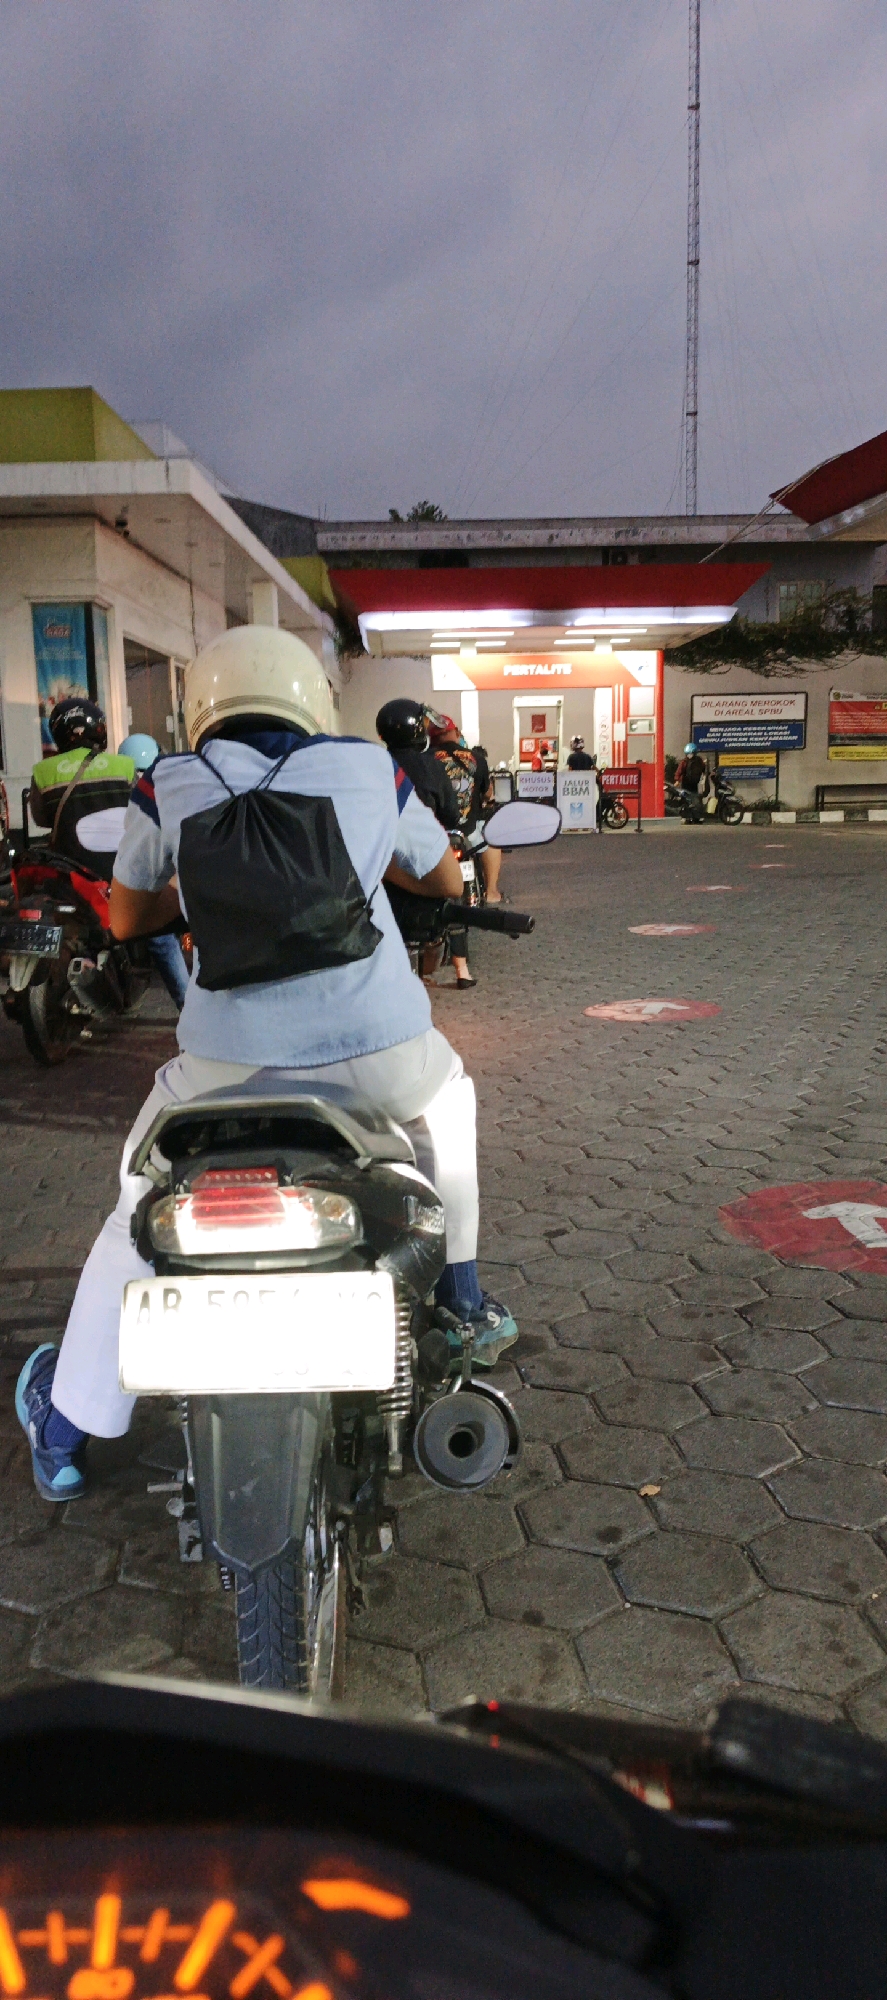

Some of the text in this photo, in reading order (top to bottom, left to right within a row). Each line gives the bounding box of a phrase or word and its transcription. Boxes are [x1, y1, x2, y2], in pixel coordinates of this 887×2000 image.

[503, 663, 572, 676] PERTALITE
[700, 699, 796, 708] DILARANG MEROKOK
[714, 709, 724, 717] DI
[725, 708, 756, 716] AREAL
[563, 779, 590, 787] JALUR
[601, 774, 639, 785] PERTALITE
[522, 785, 549, 793] MOTOR
[562, 786, 590, 796] BBM
